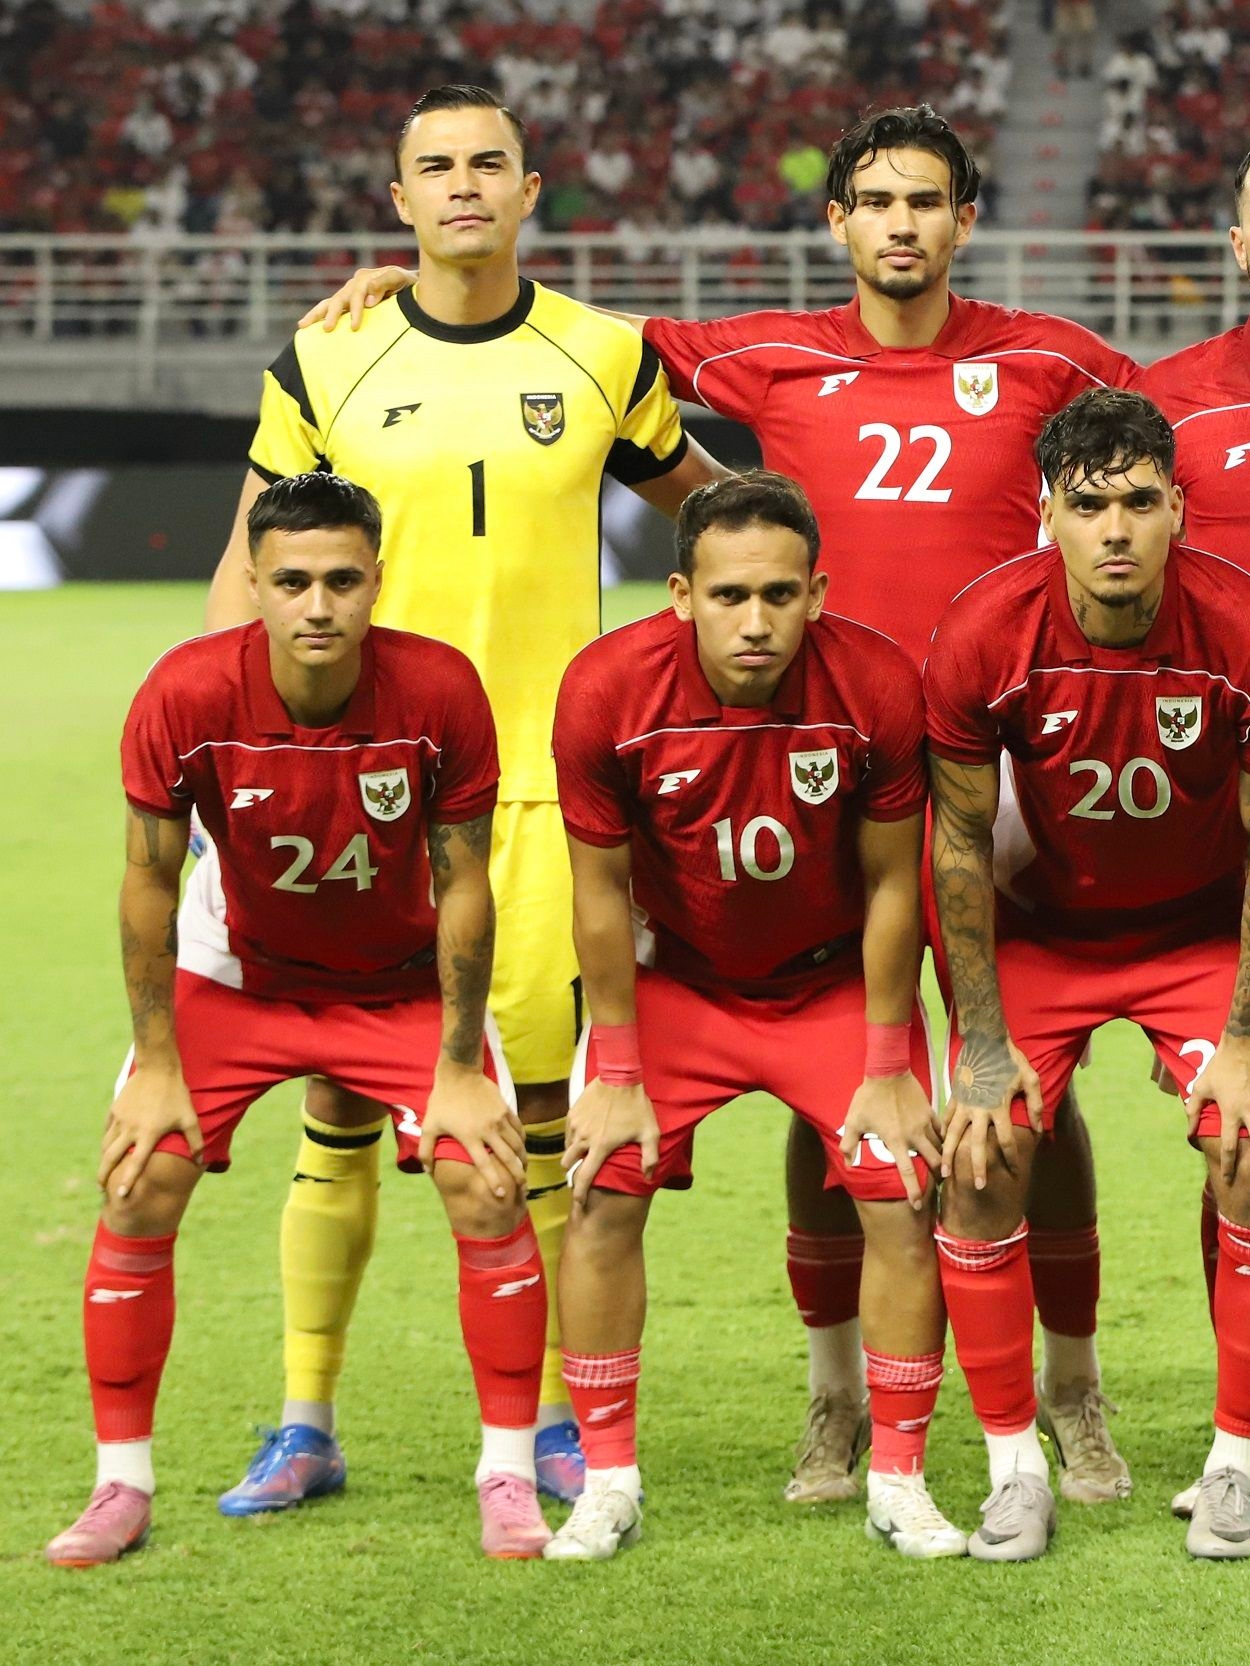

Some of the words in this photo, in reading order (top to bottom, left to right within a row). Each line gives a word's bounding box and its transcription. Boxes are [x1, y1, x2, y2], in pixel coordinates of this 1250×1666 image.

[853, 422, 953, 503] 22
[467, 459, 486, 537] 1
[1067, 757, 1172, 821] 20
[270, 833, 379, 893] 24
[711, 815, 795, 882] 10
